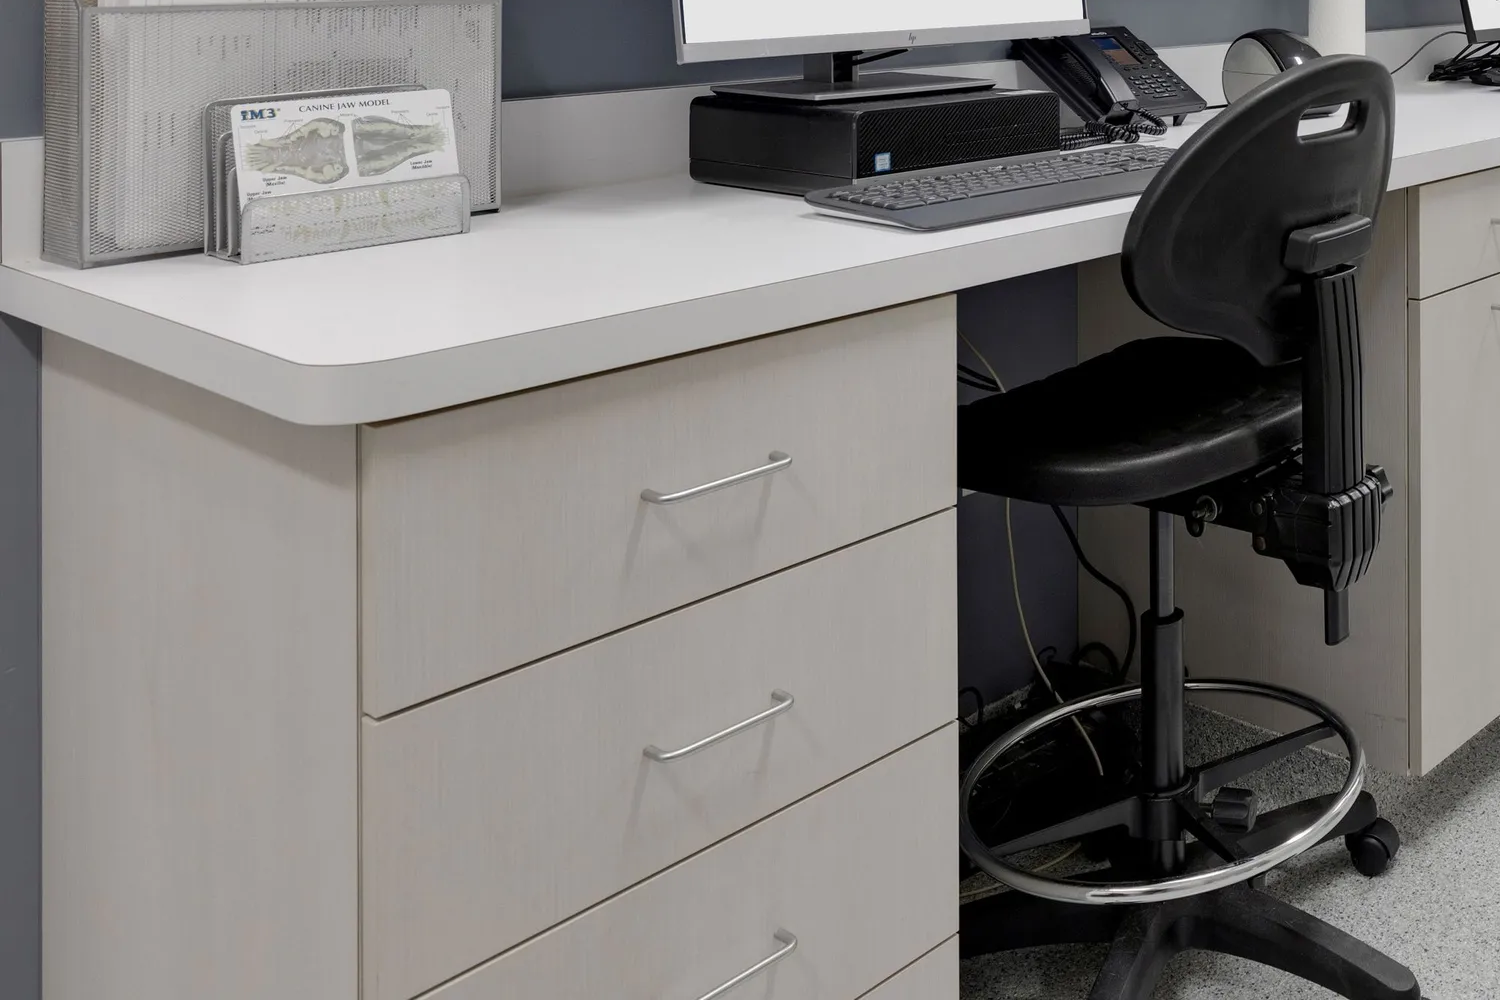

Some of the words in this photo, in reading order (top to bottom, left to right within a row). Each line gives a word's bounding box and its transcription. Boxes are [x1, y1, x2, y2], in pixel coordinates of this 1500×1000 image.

[908, 32, 917, 43] hp
[298, 103, 335, 112] CANINE
[337, 101, 356, 110] JAW
[358, 99, 390, 107] MODEL
